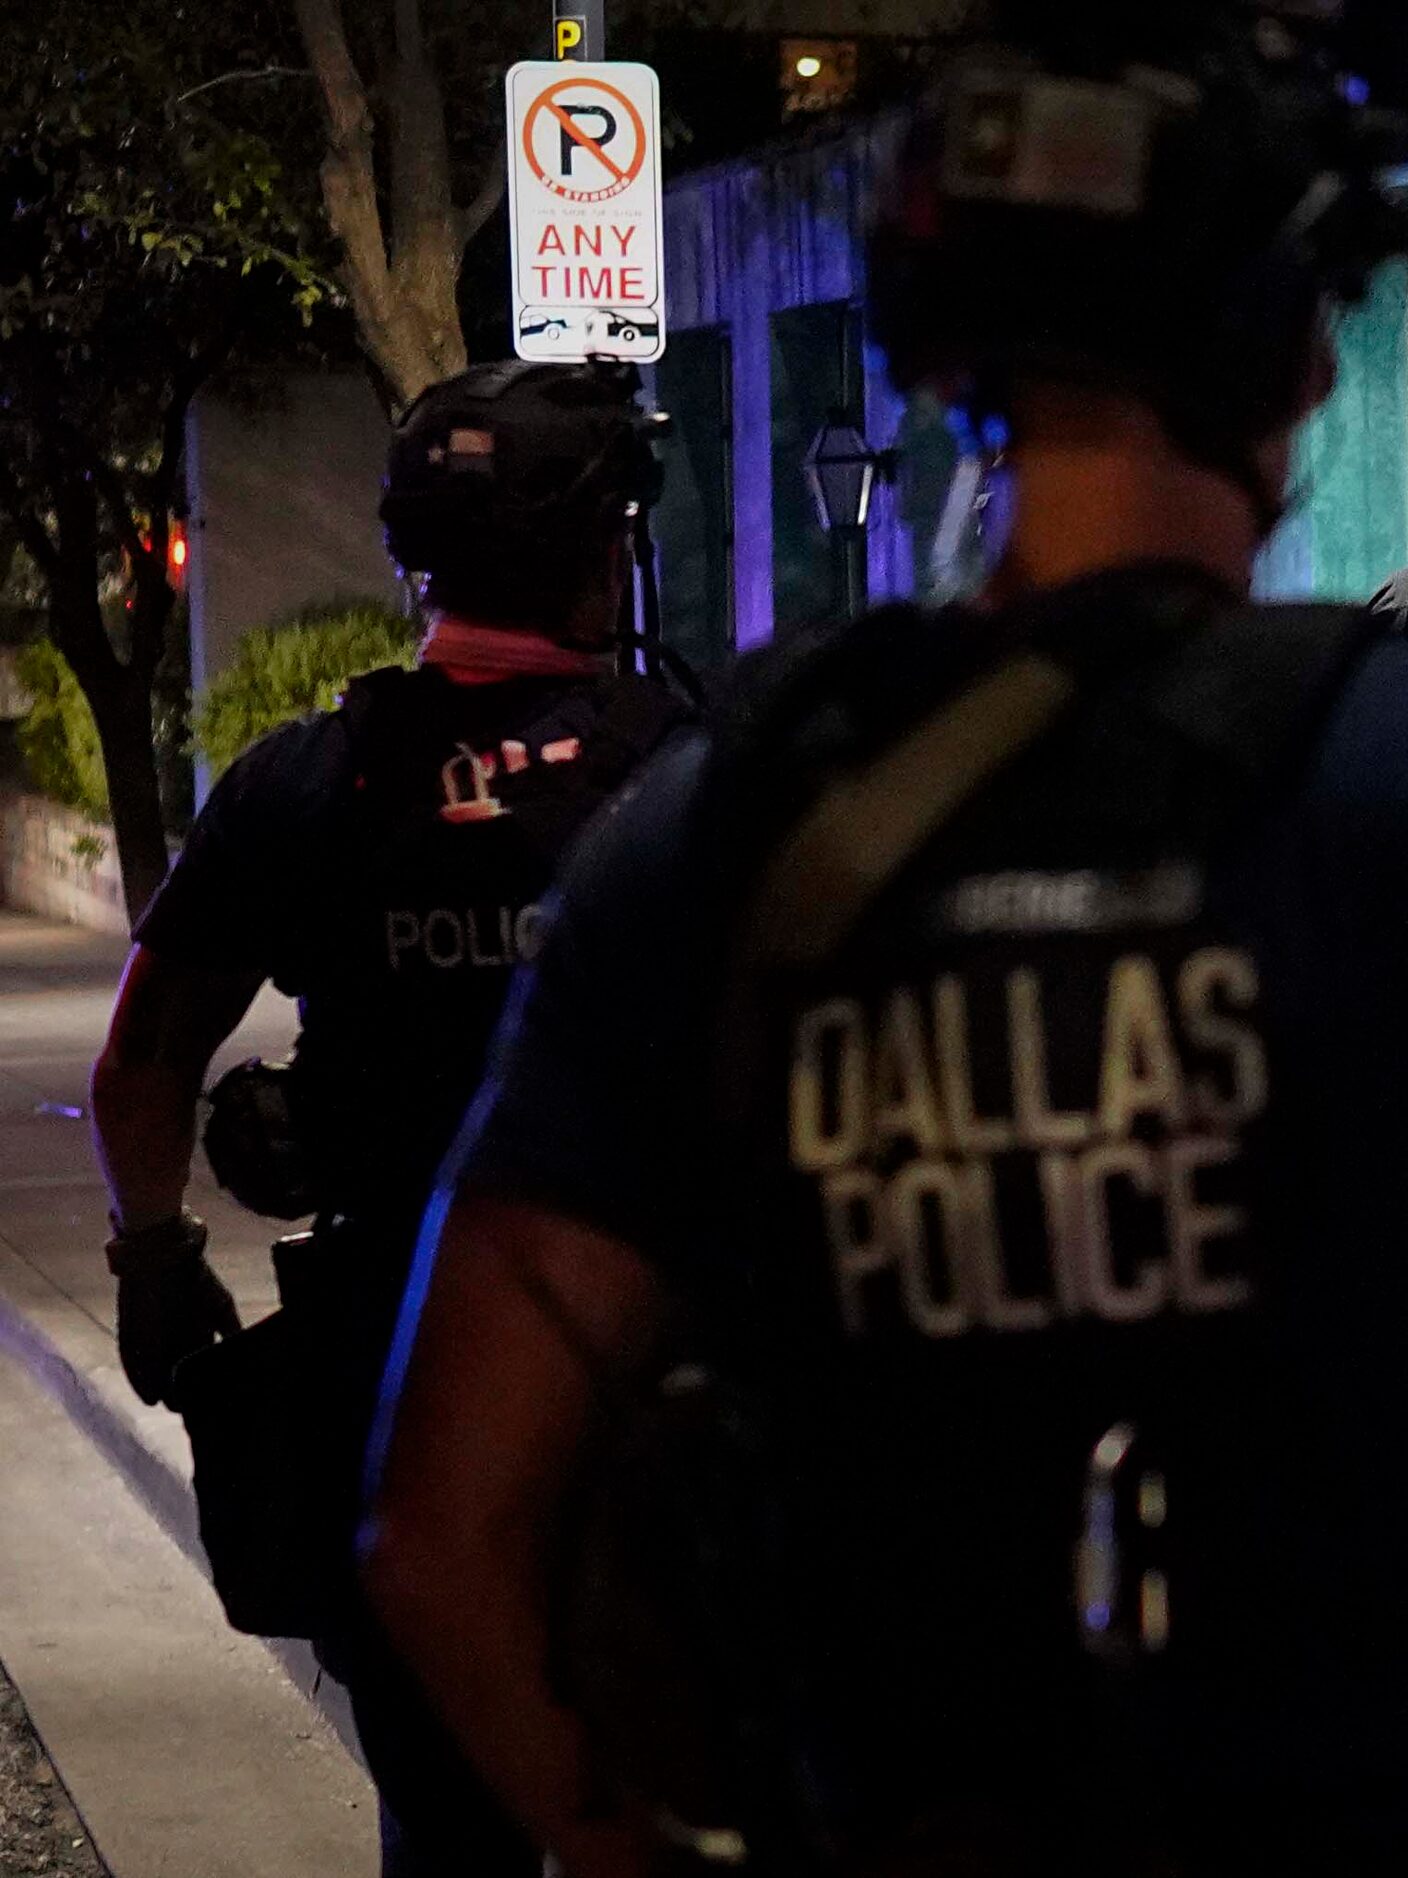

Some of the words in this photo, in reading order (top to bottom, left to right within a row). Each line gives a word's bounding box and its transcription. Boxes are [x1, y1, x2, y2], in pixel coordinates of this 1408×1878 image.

[557, 21, 581, 60] P
[538, 224, 636, 257] ANY
[531, 266, 645, 299] TIME
[790, 944, 1268, 1170] DALLAS
[821, 1136, 1254, 1338] POLICE
